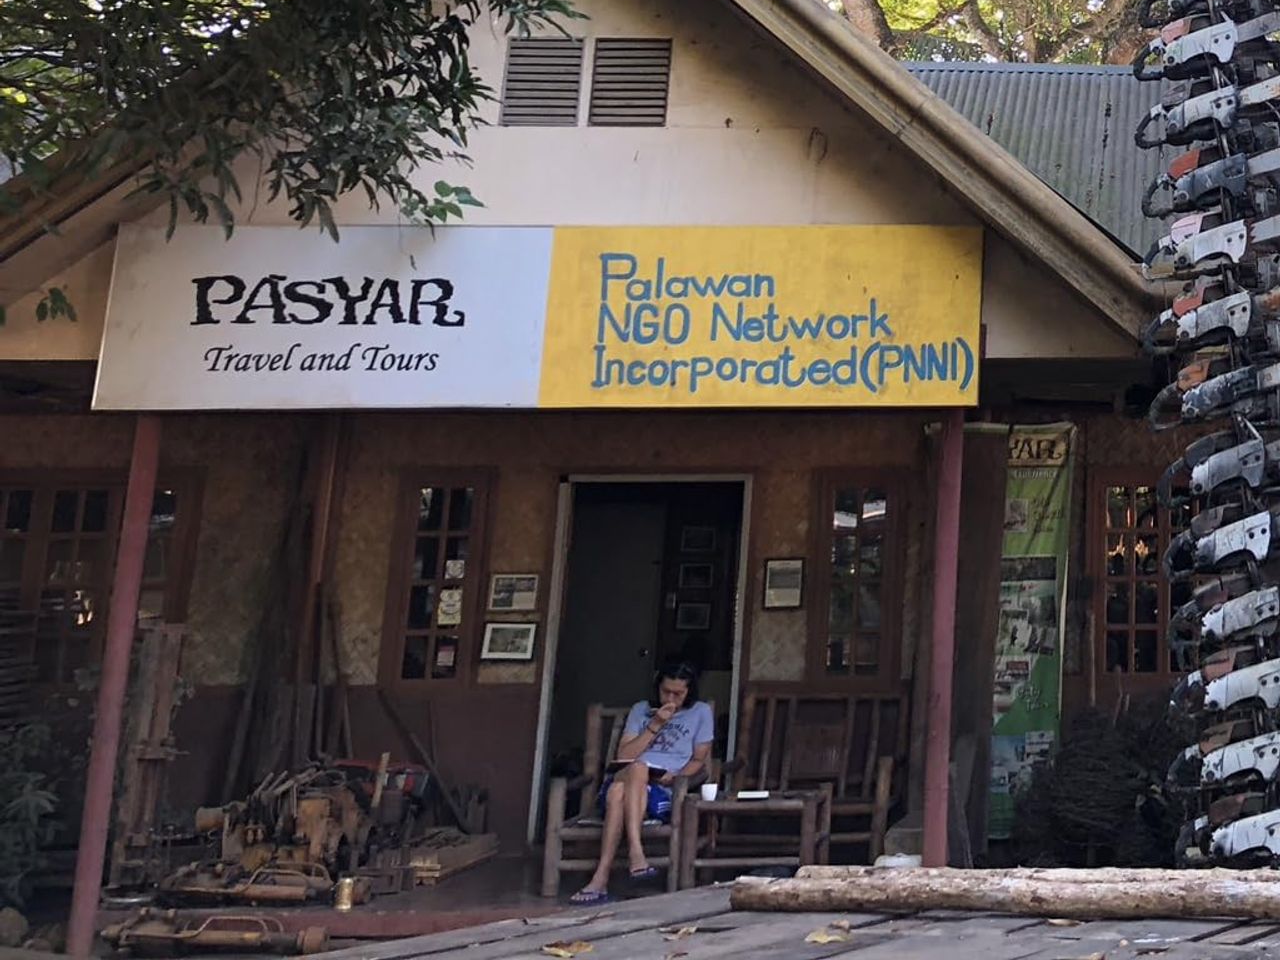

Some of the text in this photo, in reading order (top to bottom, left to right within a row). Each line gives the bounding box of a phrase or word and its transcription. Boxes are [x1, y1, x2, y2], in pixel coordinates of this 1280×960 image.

[190, 274, 465, 327] PASYAR
[600, 253, 774, 302] Palawan
[597, 297, 896, 344] NGO Network
[203, 343, 440, 372] Travel and Tours
